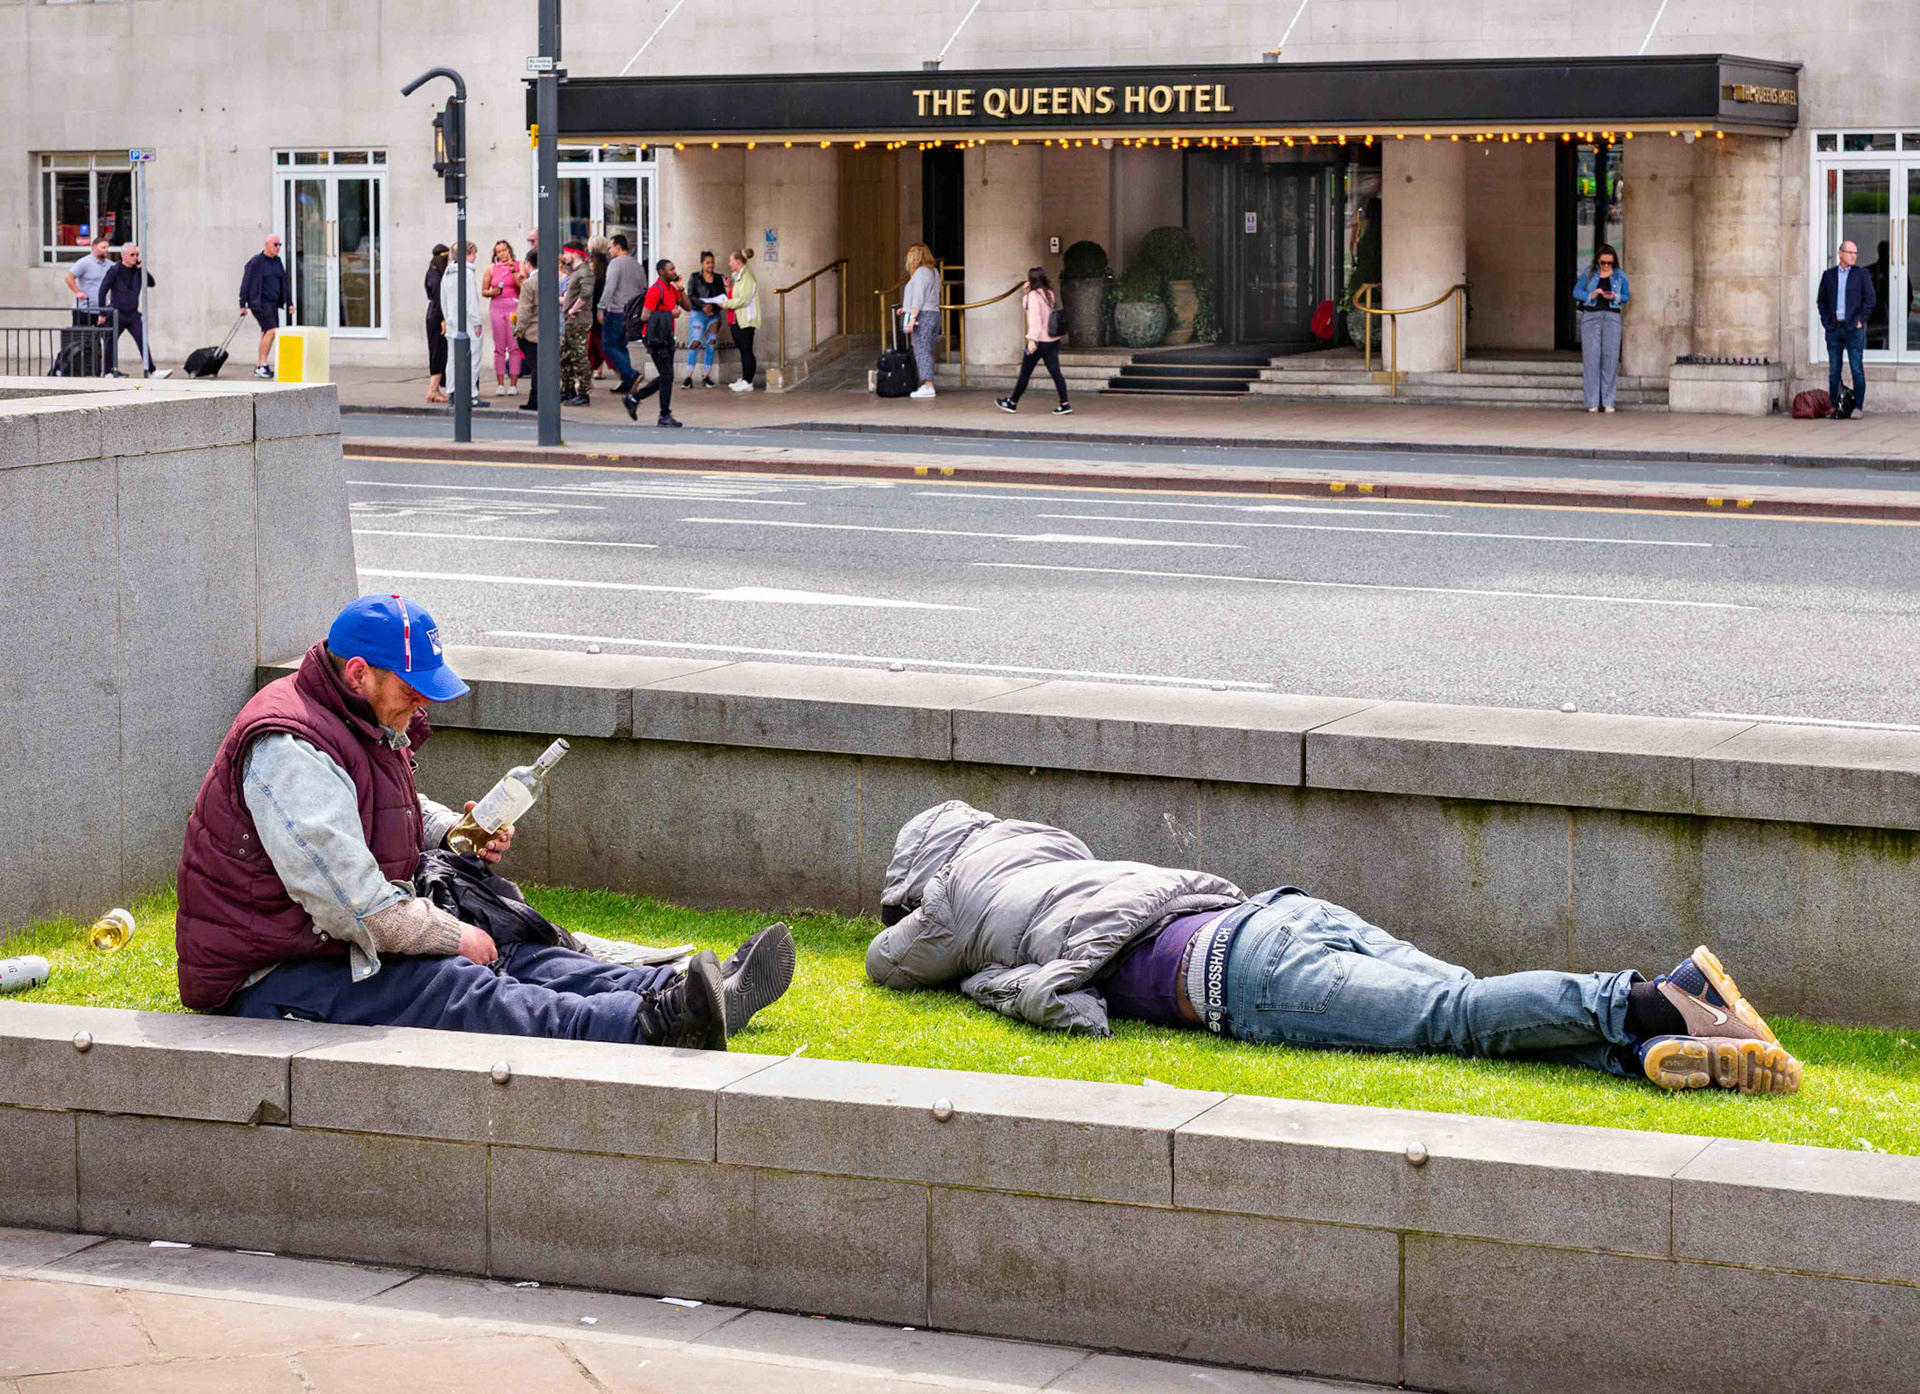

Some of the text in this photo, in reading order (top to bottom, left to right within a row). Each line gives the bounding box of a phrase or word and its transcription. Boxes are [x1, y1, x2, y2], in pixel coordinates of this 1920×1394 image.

[913, 84, 1233, 118] THE QUEENS HOTEL
[1208, 927, 1232, 1007] CROSSHATCH
